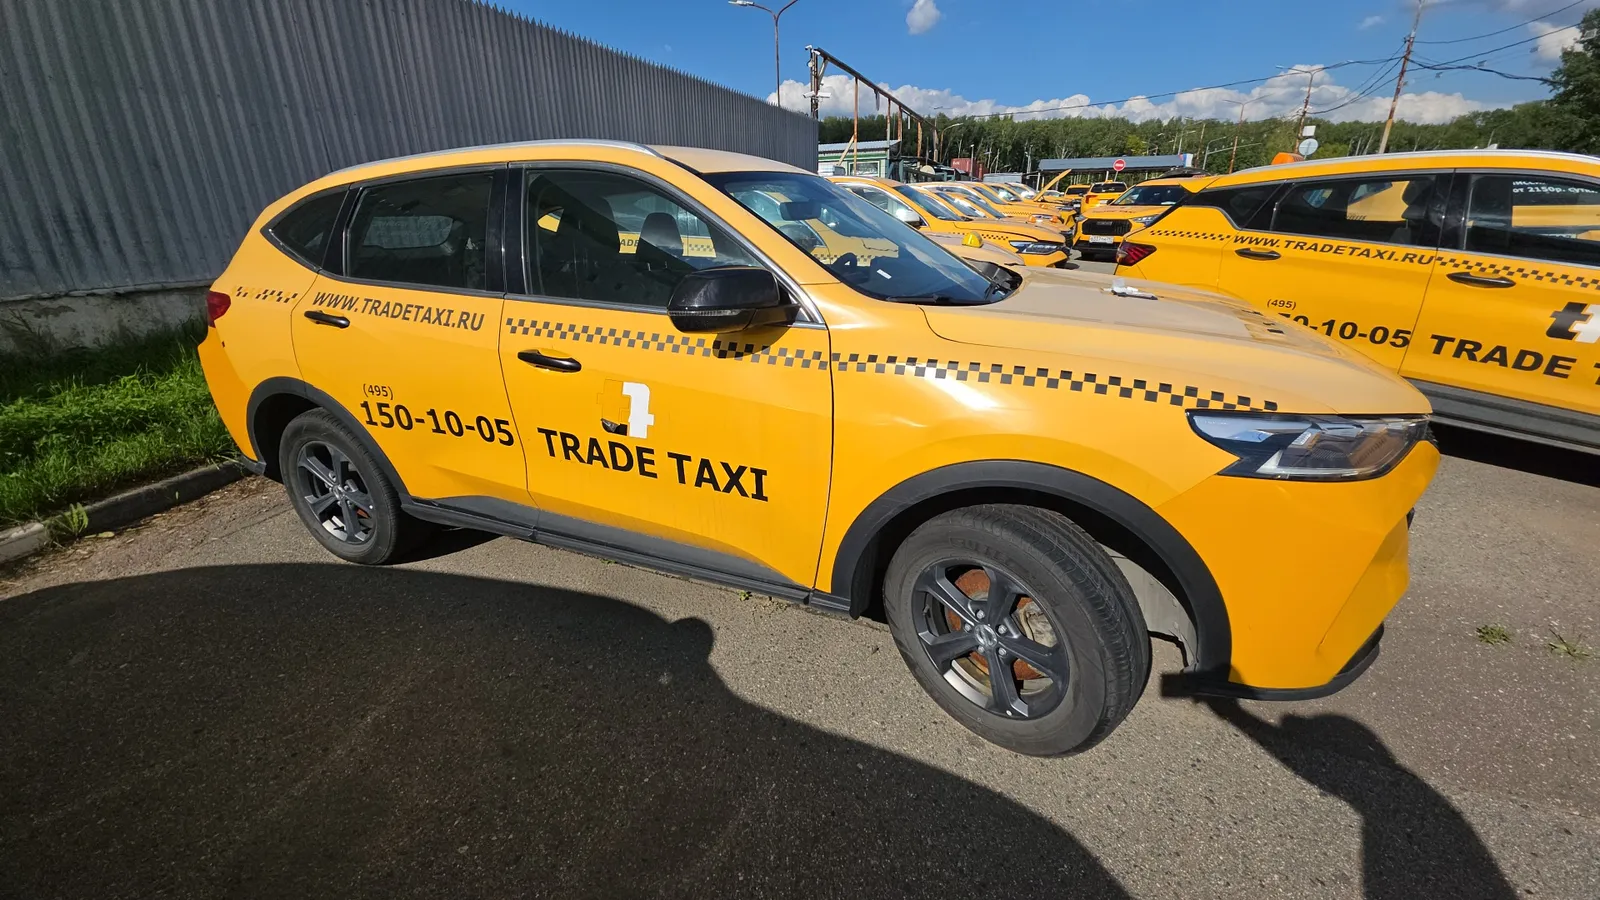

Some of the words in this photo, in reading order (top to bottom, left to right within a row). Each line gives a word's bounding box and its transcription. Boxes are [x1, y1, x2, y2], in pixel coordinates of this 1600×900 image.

[1233, 235, 1436, 265] WWW.TRADETAXI.RU
[312, 291, 485, 331] WWW.TRADETAXI.RU
[1266, 299, 1297, 310] (495)
[1278, 312, 1412, 348] 0-10-05
[1430, 334, 1578, 379] TRADE
[363, 383, 394, 400] (495)
[360, 400, 515, 446] 150-10-05
[537, 427, 659, 479] TRADE
[667, 451, 769, 502] TAXI
